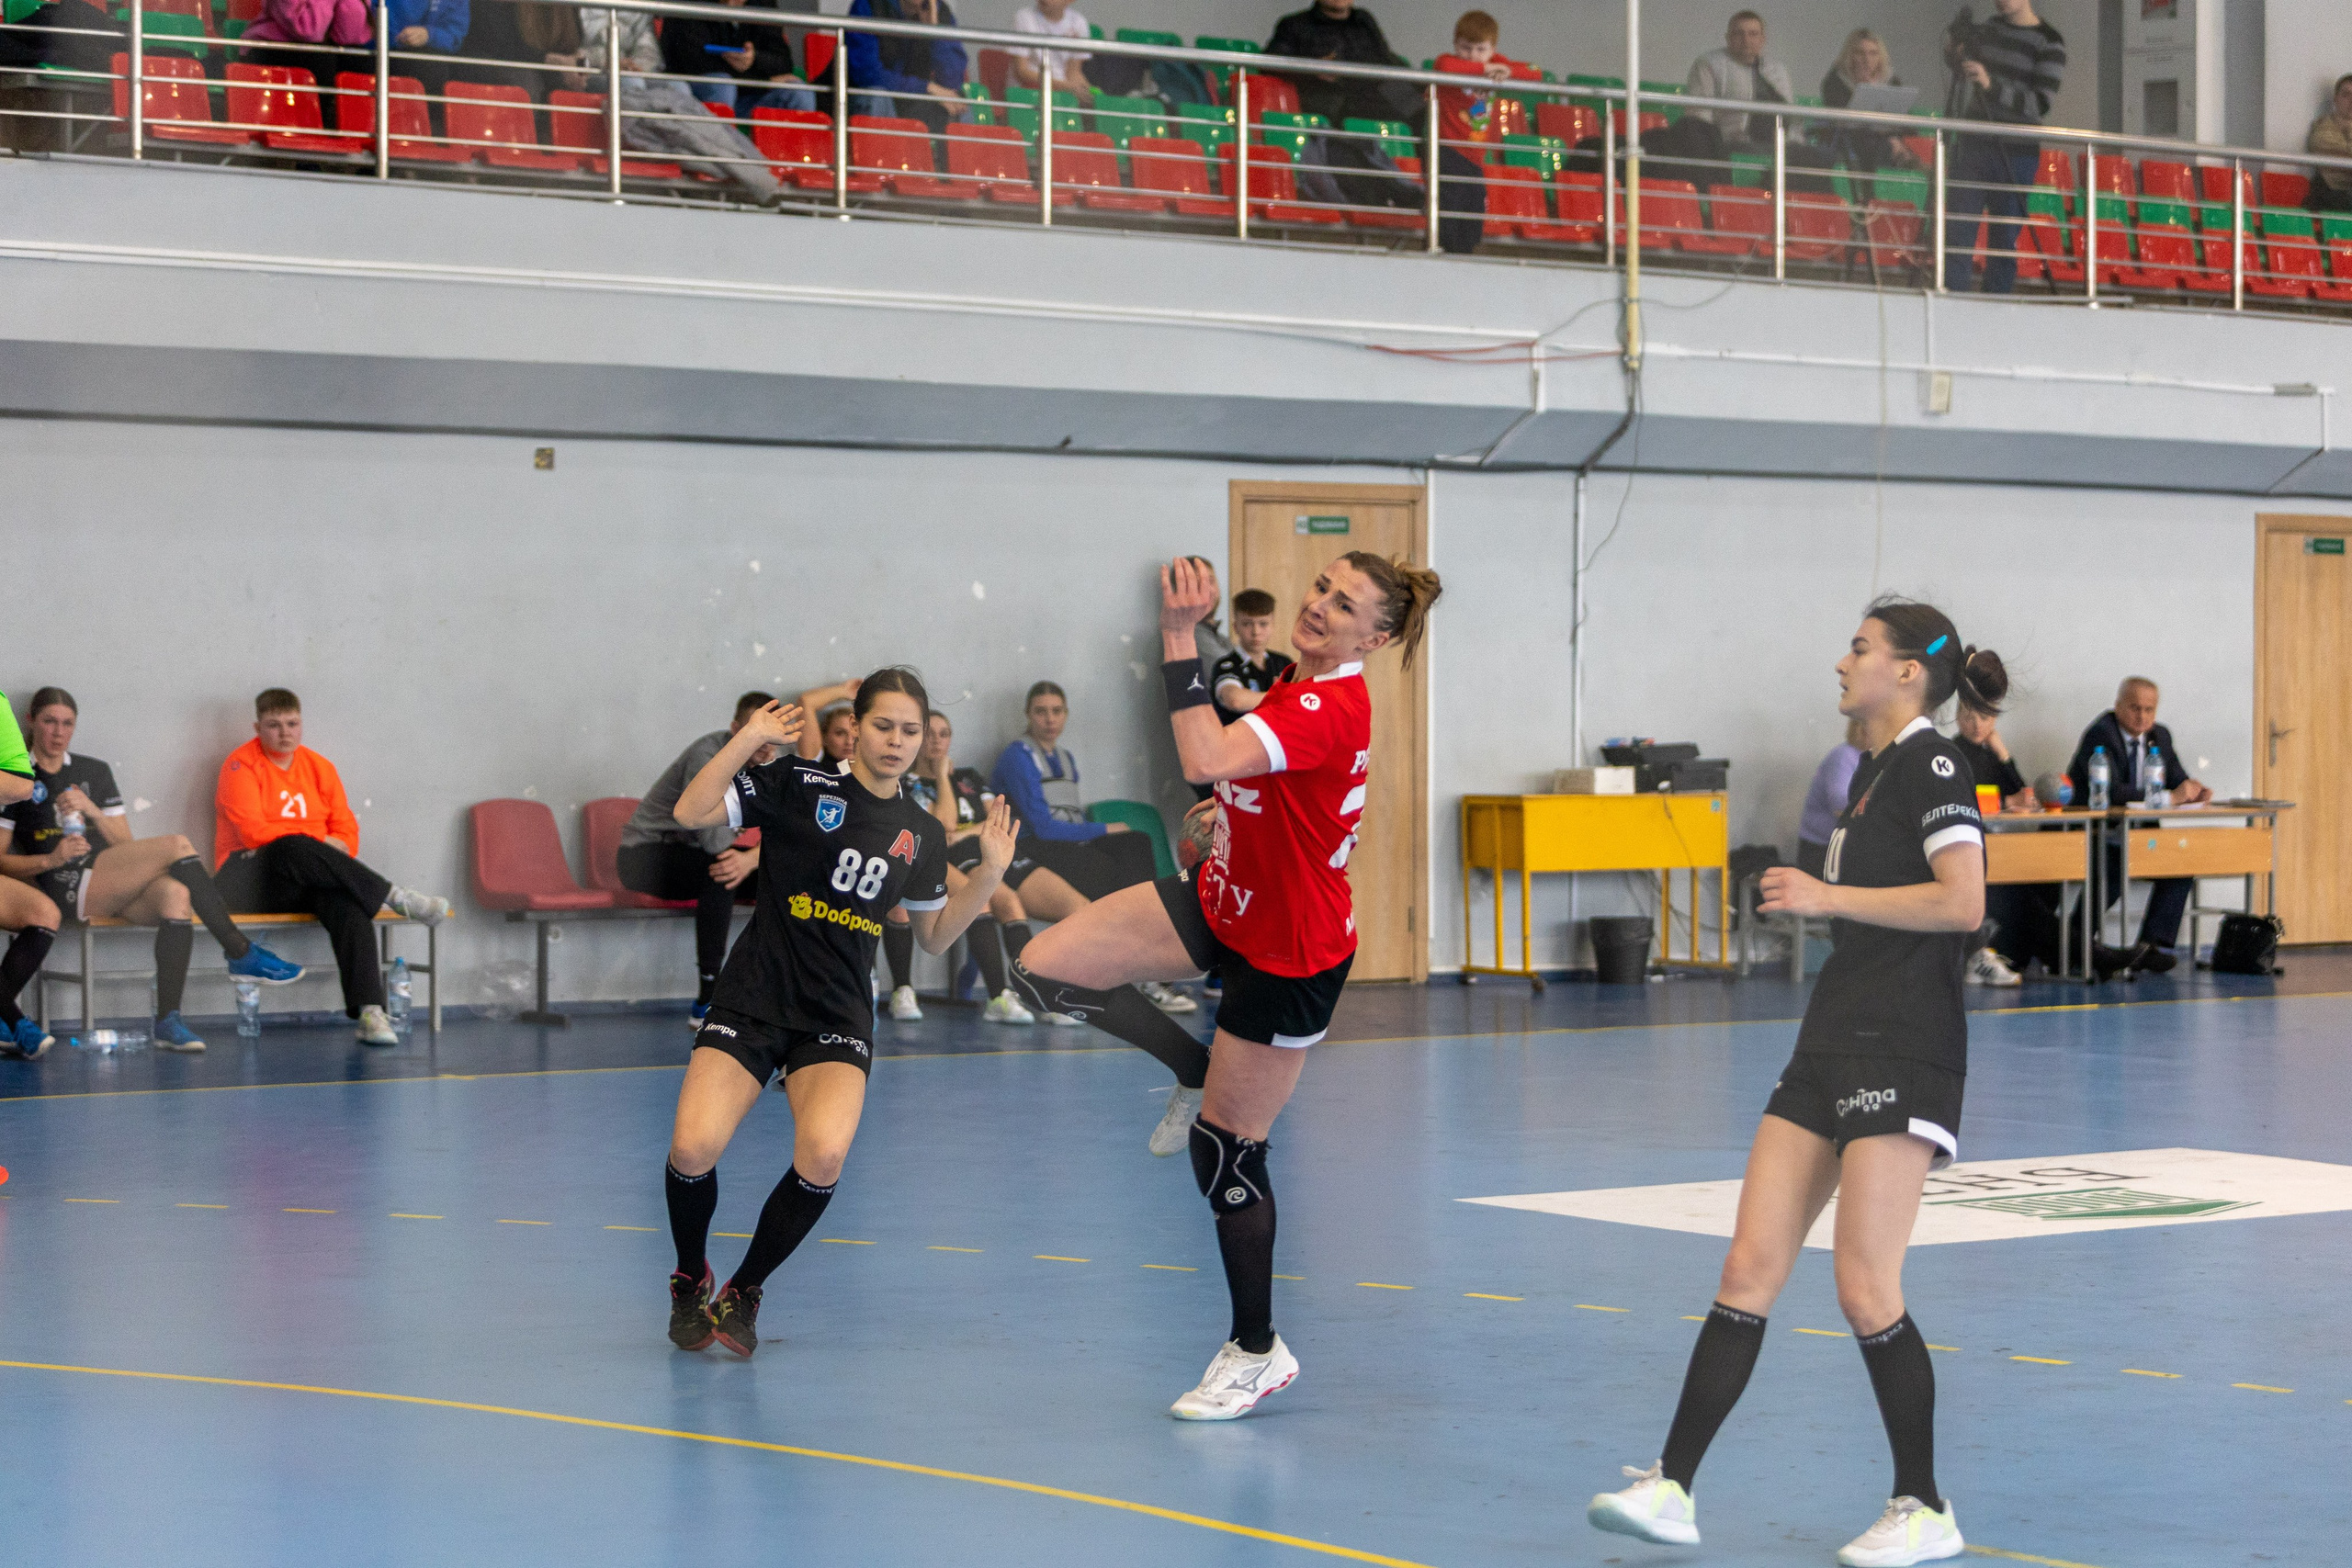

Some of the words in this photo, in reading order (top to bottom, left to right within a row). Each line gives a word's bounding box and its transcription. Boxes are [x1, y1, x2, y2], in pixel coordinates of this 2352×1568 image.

[803, 773, 840, 787] Kempa
[280, 790, 307, 818] 21
[958, 796, 976, 820] 4
[831, 848, 888, 900] 88
[705, 1021, 738, 1038] Kempa
